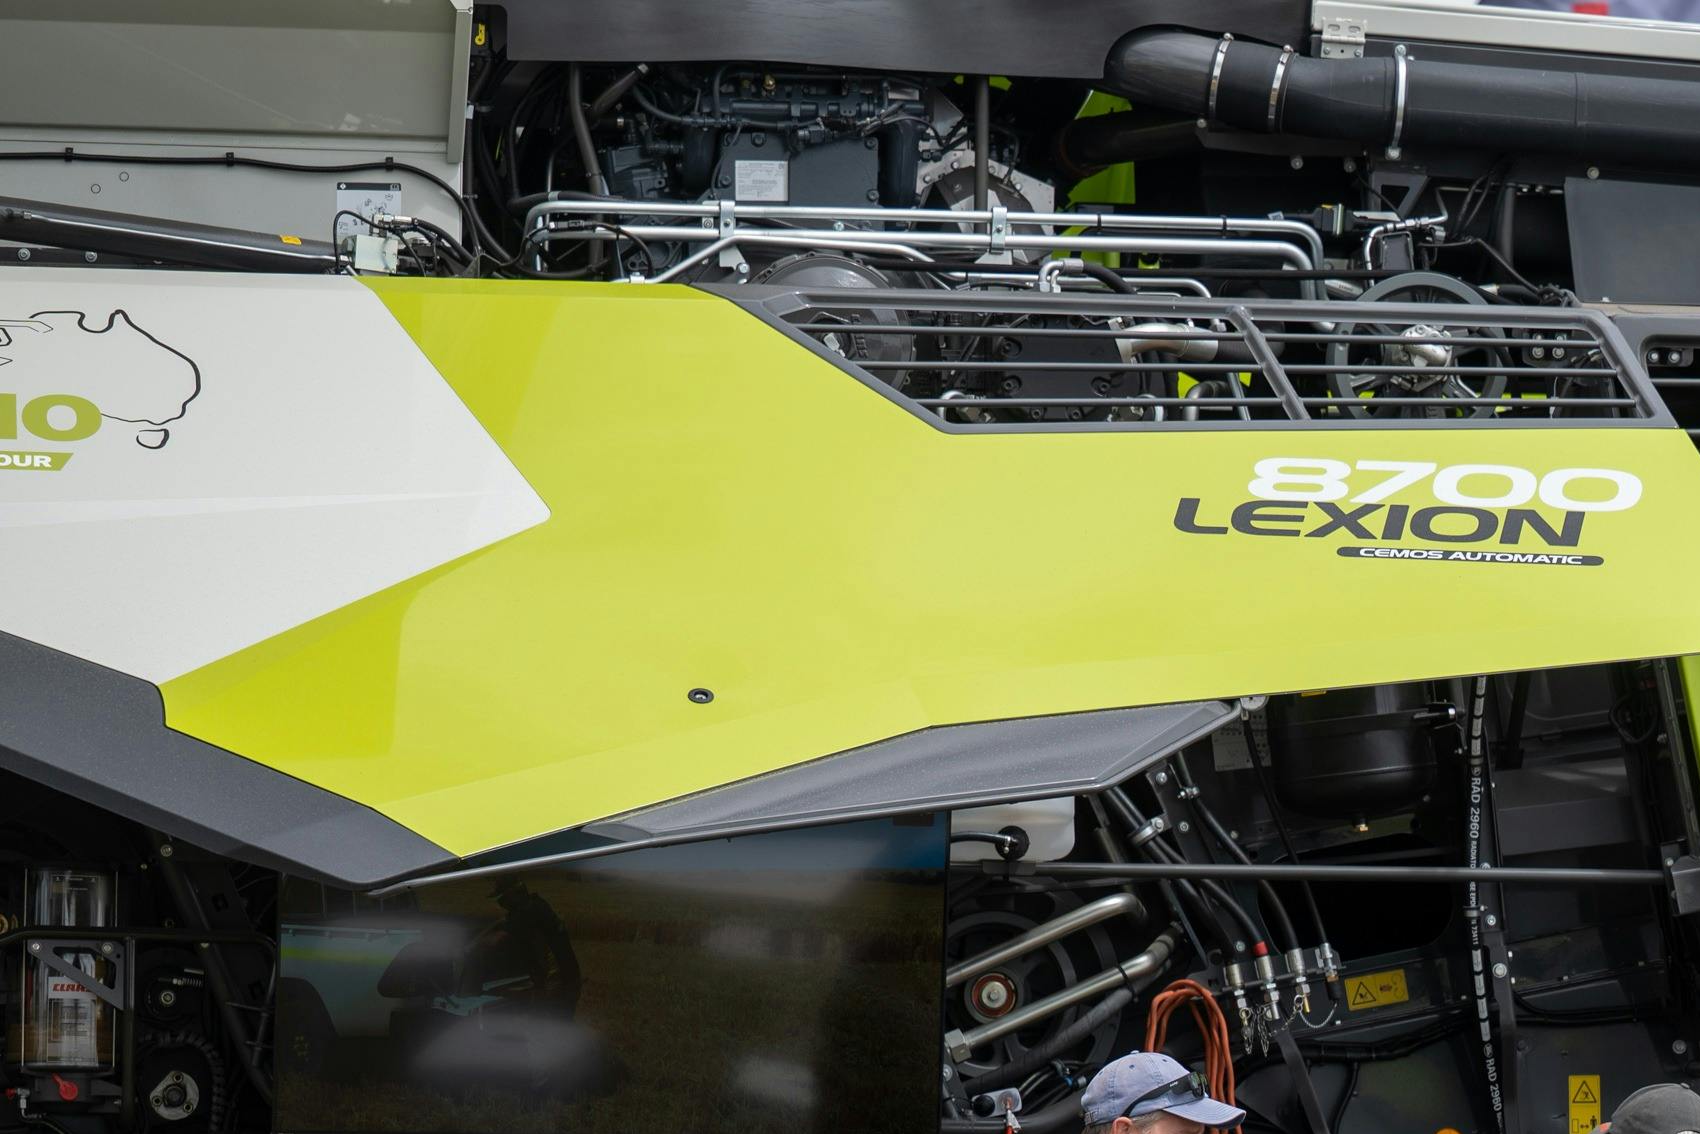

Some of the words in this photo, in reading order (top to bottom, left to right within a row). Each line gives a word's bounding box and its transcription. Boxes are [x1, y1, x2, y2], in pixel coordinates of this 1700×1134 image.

[1247, 457, 1643, 512] 8700
[1173, 497, 1586, 547] LEXION
[1359, 547, 1443, 561] CEMOS
[1448, 550, 1583, 565] AUTOMATIC
[1471, 777, 1482, 803] RAD
[1469, 806, 1480, 839] 2960
[52, 983, 92, 993] CLAA
[1486, 1058, 1497, 1082] RAD
